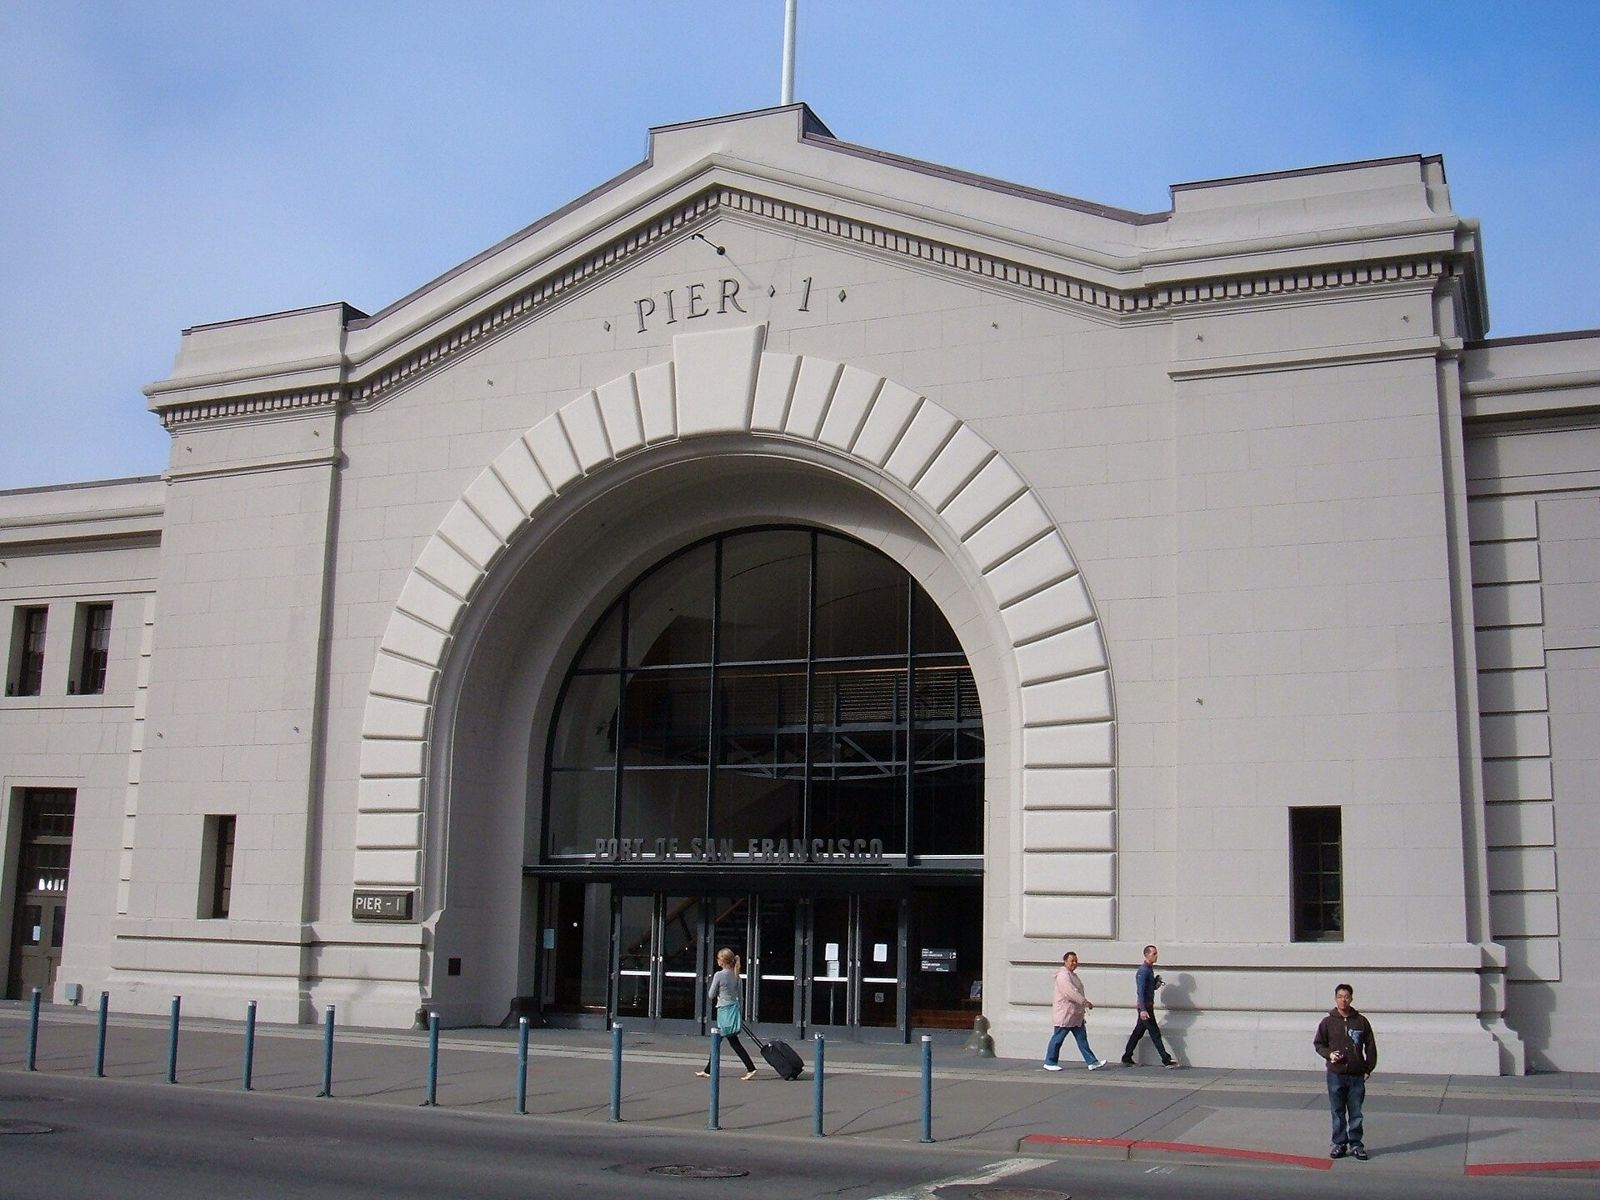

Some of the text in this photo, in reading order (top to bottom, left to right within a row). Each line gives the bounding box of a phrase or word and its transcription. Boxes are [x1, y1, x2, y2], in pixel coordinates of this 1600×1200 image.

[633, 276, 813, 334] PIER 1
[595, 837, 882, 862] PORT OF SAN FRANCISCO
[355, 897, 382, 911] PIER
